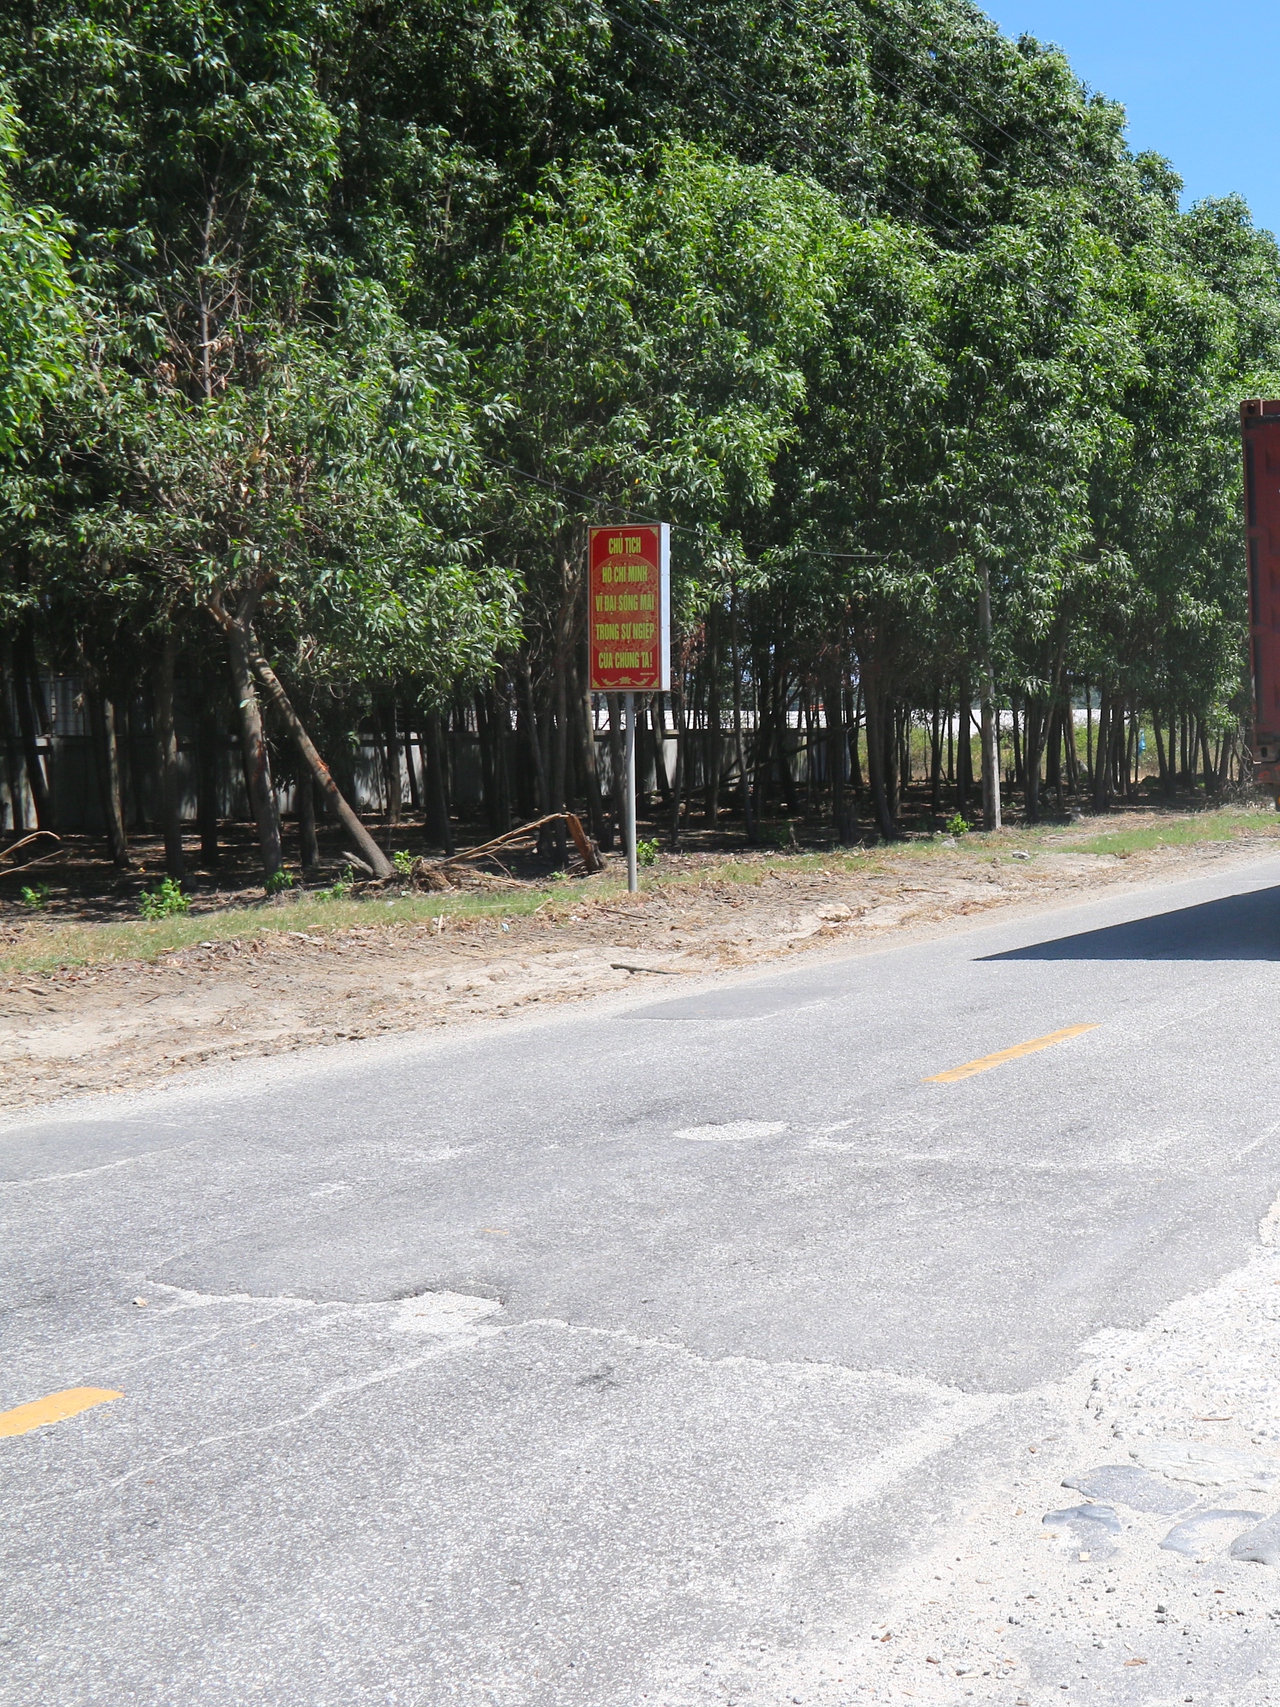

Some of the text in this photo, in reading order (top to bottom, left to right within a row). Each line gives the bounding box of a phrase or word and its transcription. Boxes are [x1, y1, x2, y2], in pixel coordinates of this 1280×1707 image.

[608, 532, 641, 557] CHỦ TỊCH
[602, 561, 648, 583] HỒ CHÍ MINH
[604, 595, 616, 615] ĐẠI
[618, 589, 638, 611] SỐNG
[596, 623, 619, 640] TRONG
[621, 622, 632, 643] SỰ
[598, 647, 613, 668] CỦA
[615, 648, 640, 668] CHÚNG
